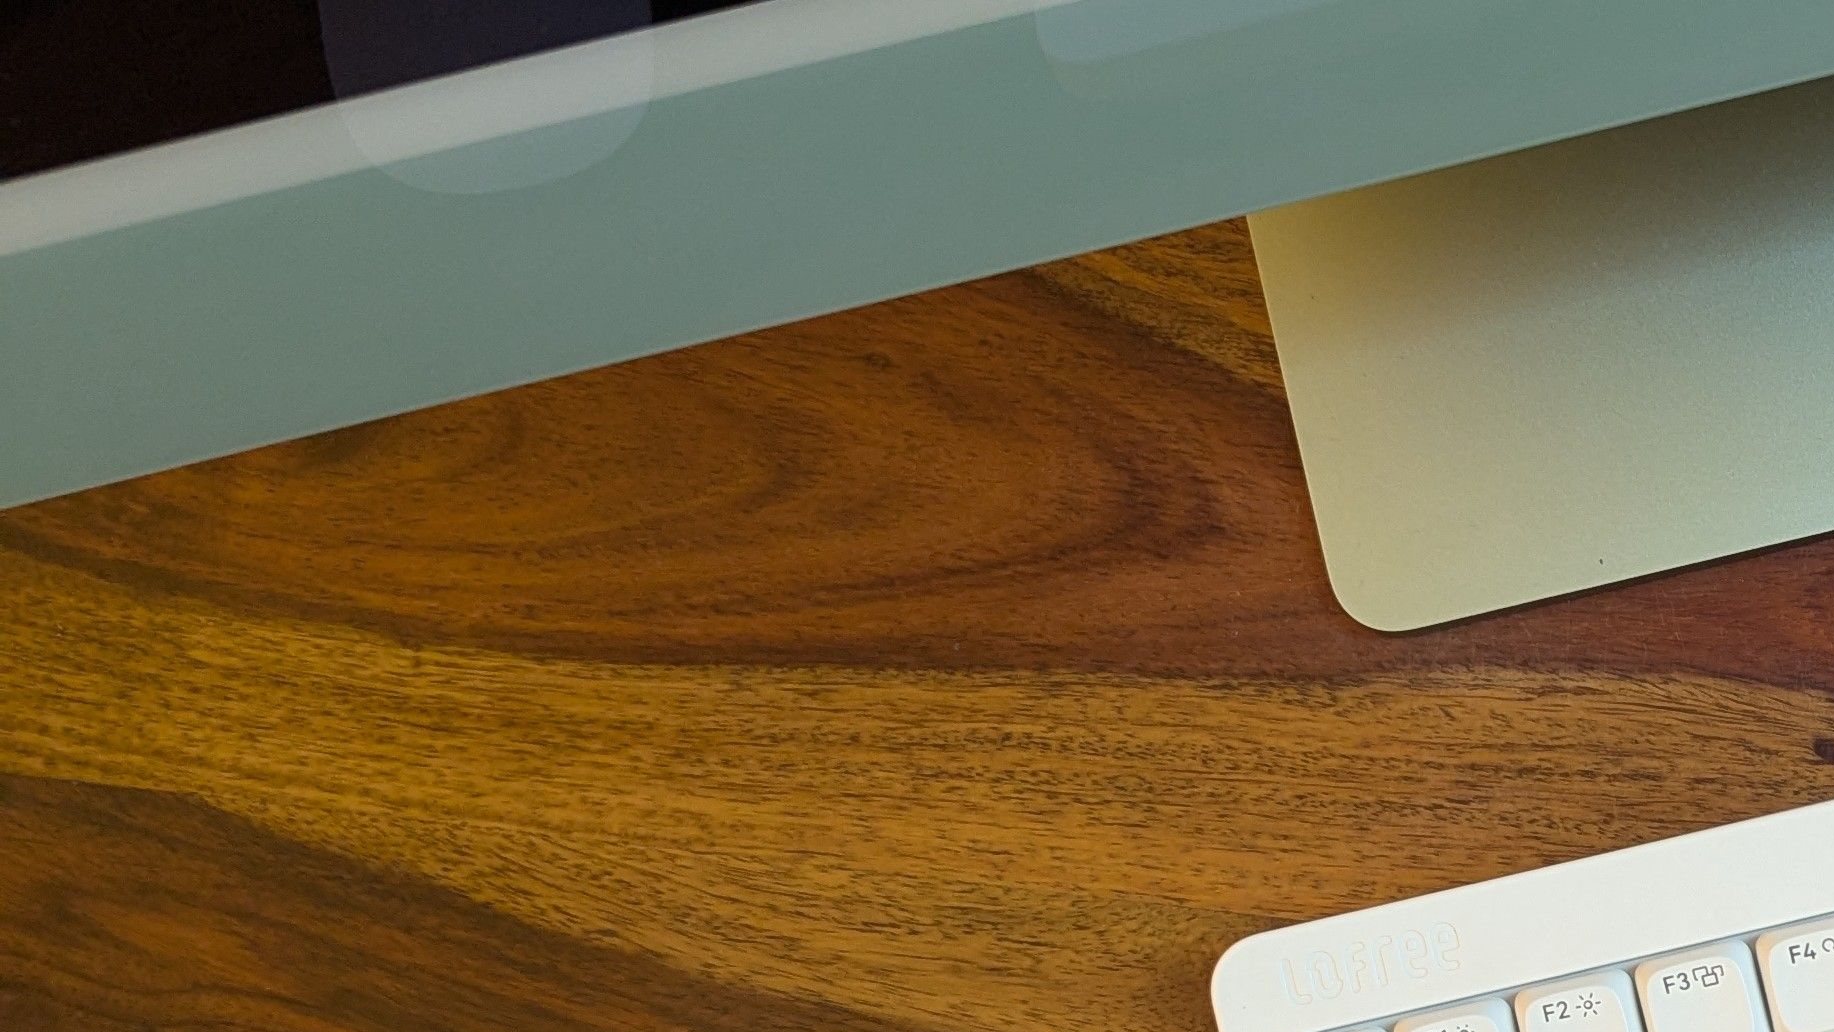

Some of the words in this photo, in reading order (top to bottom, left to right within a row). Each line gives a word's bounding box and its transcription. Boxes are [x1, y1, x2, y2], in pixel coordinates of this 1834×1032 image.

[1787, 942, 1818, 965] F4
[1662, 971, 1692, 995] F3
[1541, 1000, 1571, 1023] F2
